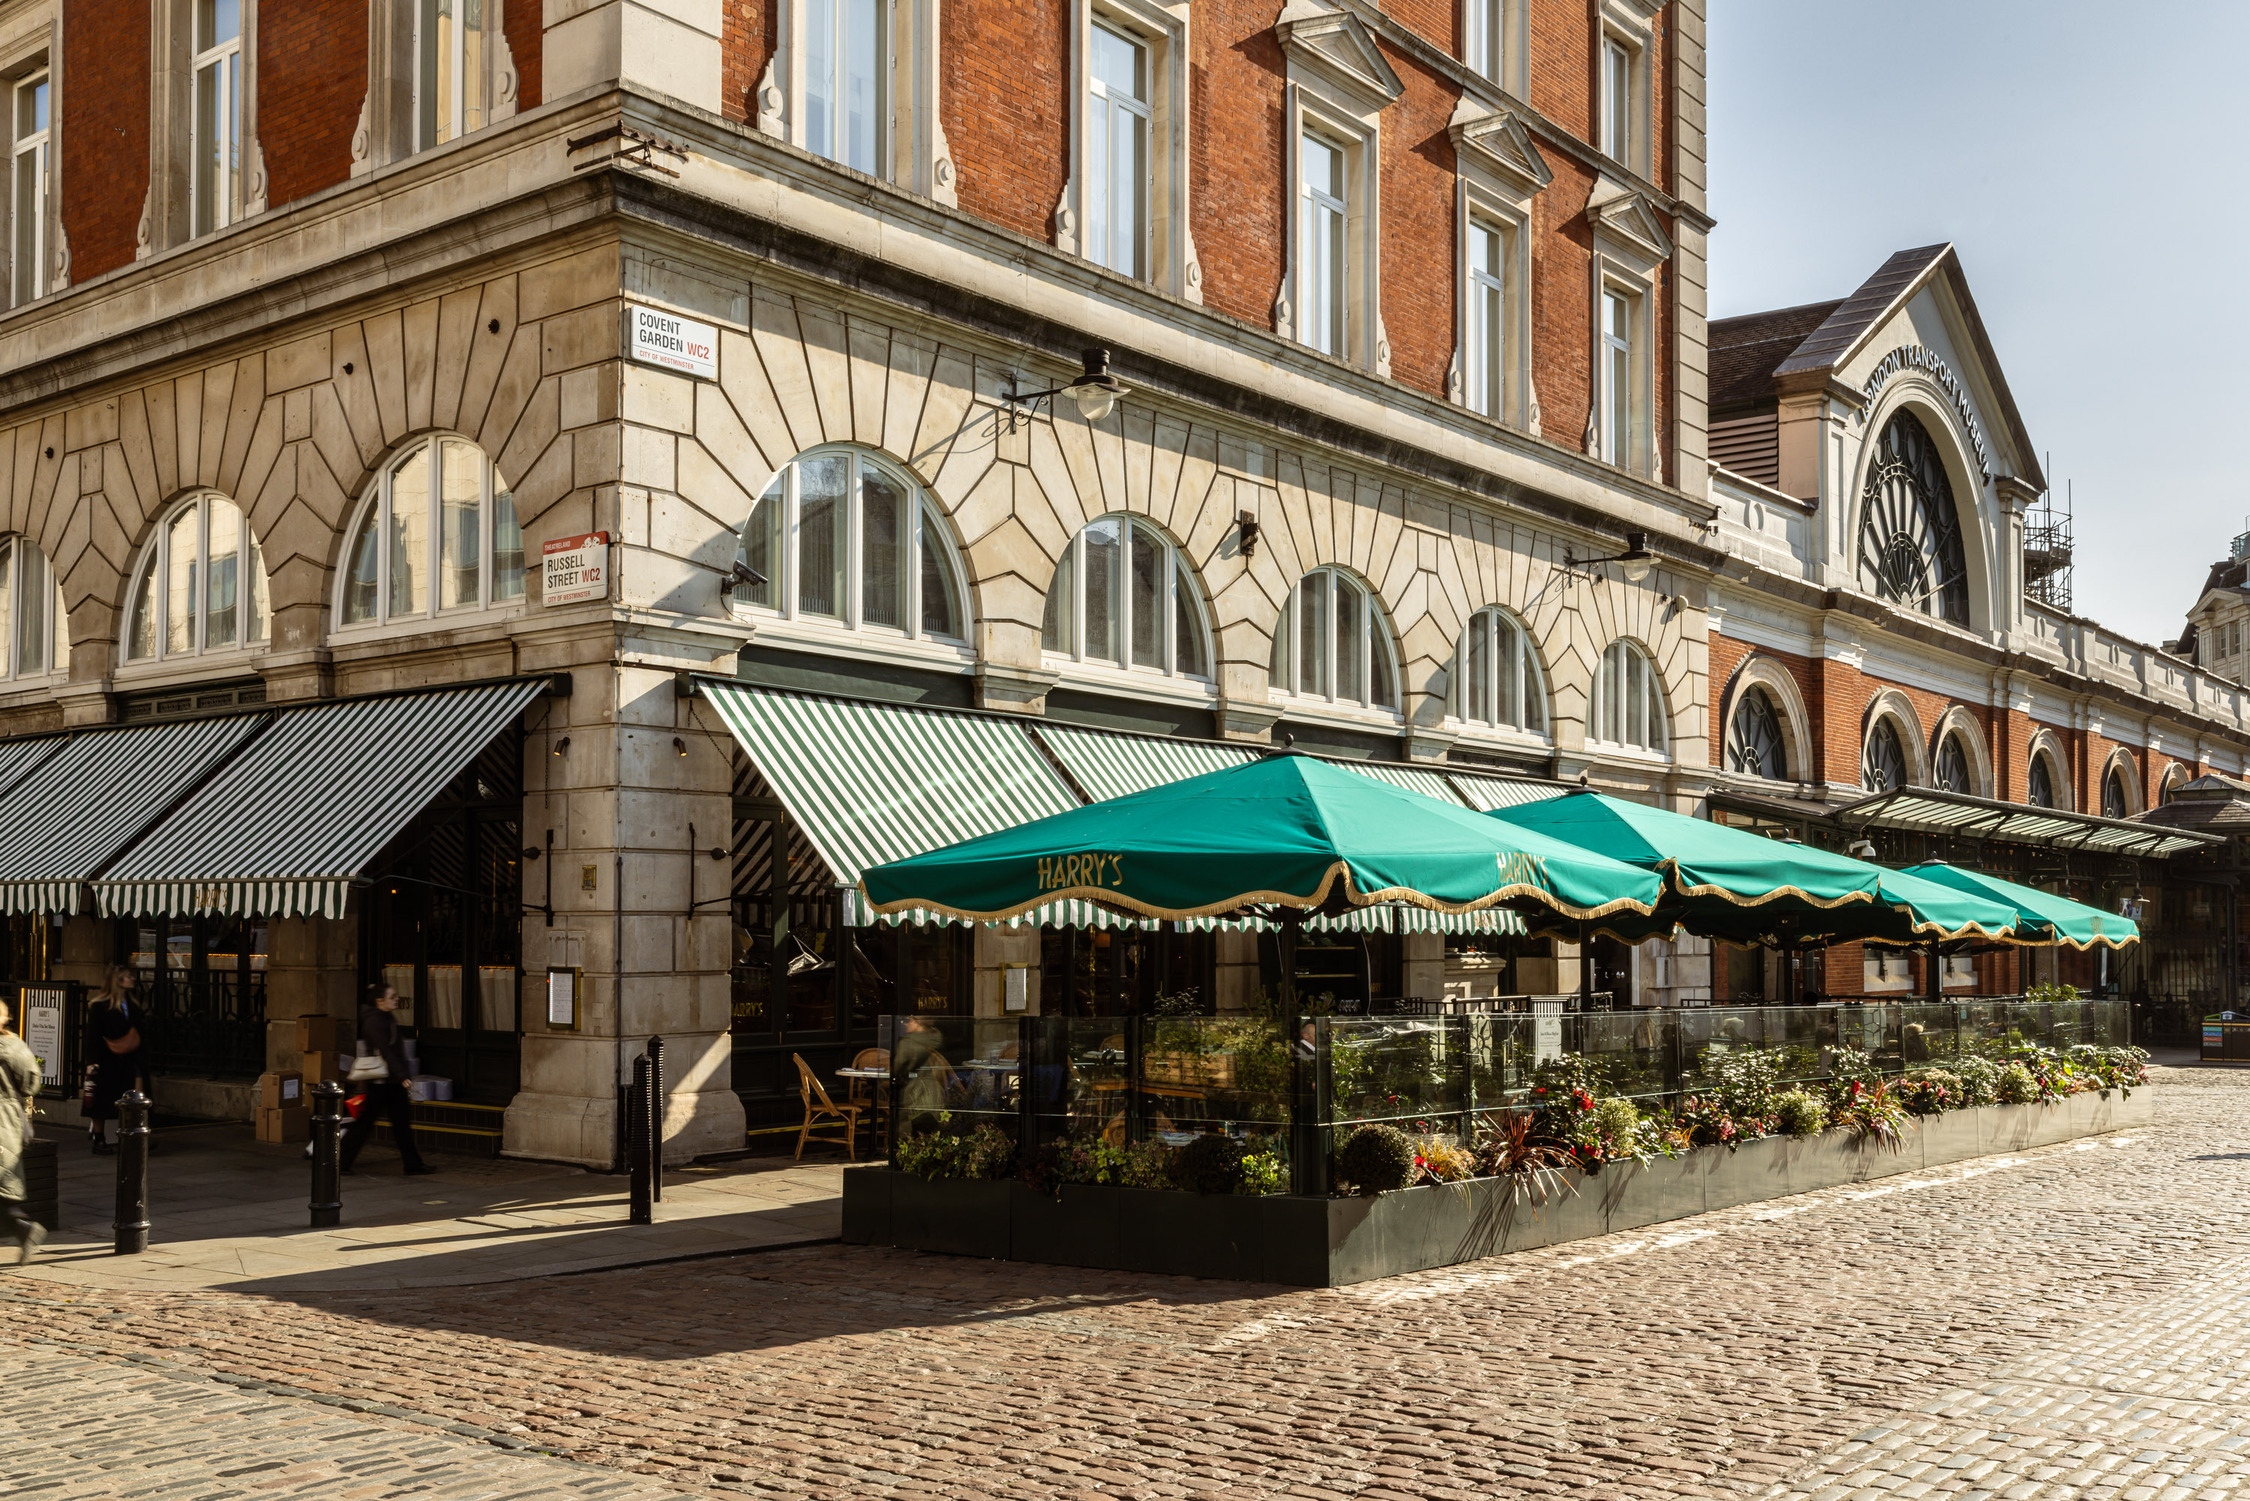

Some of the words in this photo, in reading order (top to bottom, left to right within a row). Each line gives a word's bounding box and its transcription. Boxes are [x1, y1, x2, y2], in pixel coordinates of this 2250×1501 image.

[639, 312, 681, 335] COVENT
[639, 328, 683, 353] GARDEN
[687, 341, 710, 360] WC2
[639, 350, 651, 358] CITY
[651, 353, 659, 361] OF
[660, 355, 694, 370] WESTMINSTER
[1862, 348, 1901, 423] LONDON
[1902, 345, 1958, 396] TRANSPORT
[544, 540, 571, 551] THEATRELAND
[547, 554, 585, 573] RUSSELL
[547, 571, 579, 589] STREET
[581, 567, 601, 583] WC2
[547, 596, 556, 604] CITY
[563, 590, 591, 601] WESTMINSTER
[1037, 853, 1124, 890] HARRY'S
[1496, 851, 1548, 886] HARRY'S
[194, 889, 228, 908] HARRY'S
[918, 996, 948, 1010] HARRY'S
